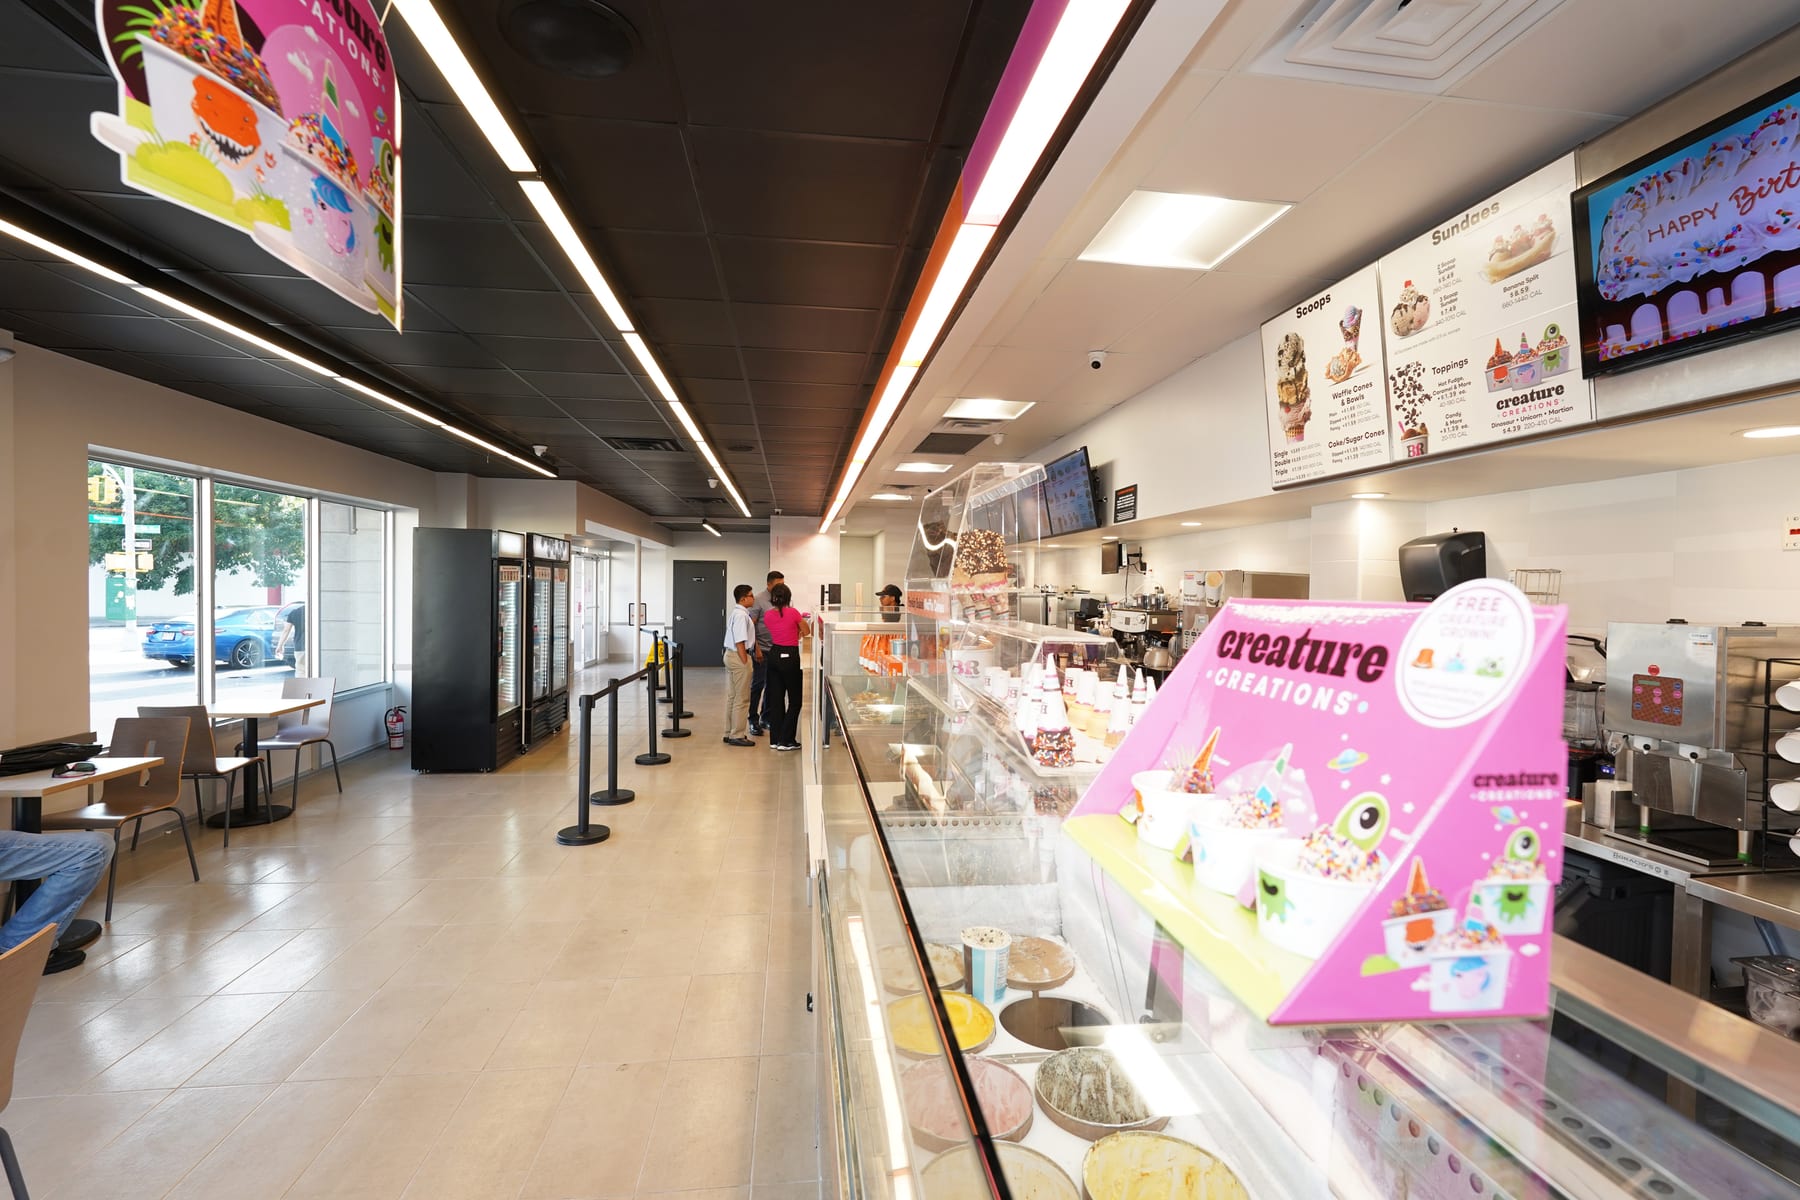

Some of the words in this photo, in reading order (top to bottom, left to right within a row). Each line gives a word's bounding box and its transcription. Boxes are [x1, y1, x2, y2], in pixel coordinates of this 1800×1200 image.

[1432, 202, 1500, 246] Sundaes
[1647, 202, 1719, 243] HAPPY
[1503, 279, 1525, 294] Banana
[1526, 274, 1540, 285] Split
[1529, 289, 1543, 299] CAL
[1295, 292, 1331, 319] Scoops
[1431, 358, 1469, 375] Toppings
[1332, 388, 1352, 400] Waffle
[1353, 382, 1373, 393] Cones
[1432, 385, 1453, 396] Caramel
[1458, 380, 1472, 390] More
[1346, 394, 1365, 404] Bowls
[1496, 384, 1565, 411] creature
[1445, 411, 1462, 420] Candy
[1502, 399, 1560, 418] CREATIONS
[1449, 418, 1463, 426] More
[1491, 419, 1515, 429] Dinosaur
[1520, 412, 1543, 422] Unicorn
[1548, 406, 1574, 416] Martian
[1549, 416, 1563, 425] CAL
[1328, 435, 1363, 449] Cake/Sugar
[1364, 429, 1385, 440] Cones
[1274, 450, 1289, 460] Single
[1274, 459, 1290, 468] Double
[1275, 469, 1288, 477] Triple
[1455, 596, 1501, 612] FREE
[1216, 627, 1390, 684] creature
[1213, 667, 1358, 716] CREATIONS
[1473, 772, 1559, 788] creature
